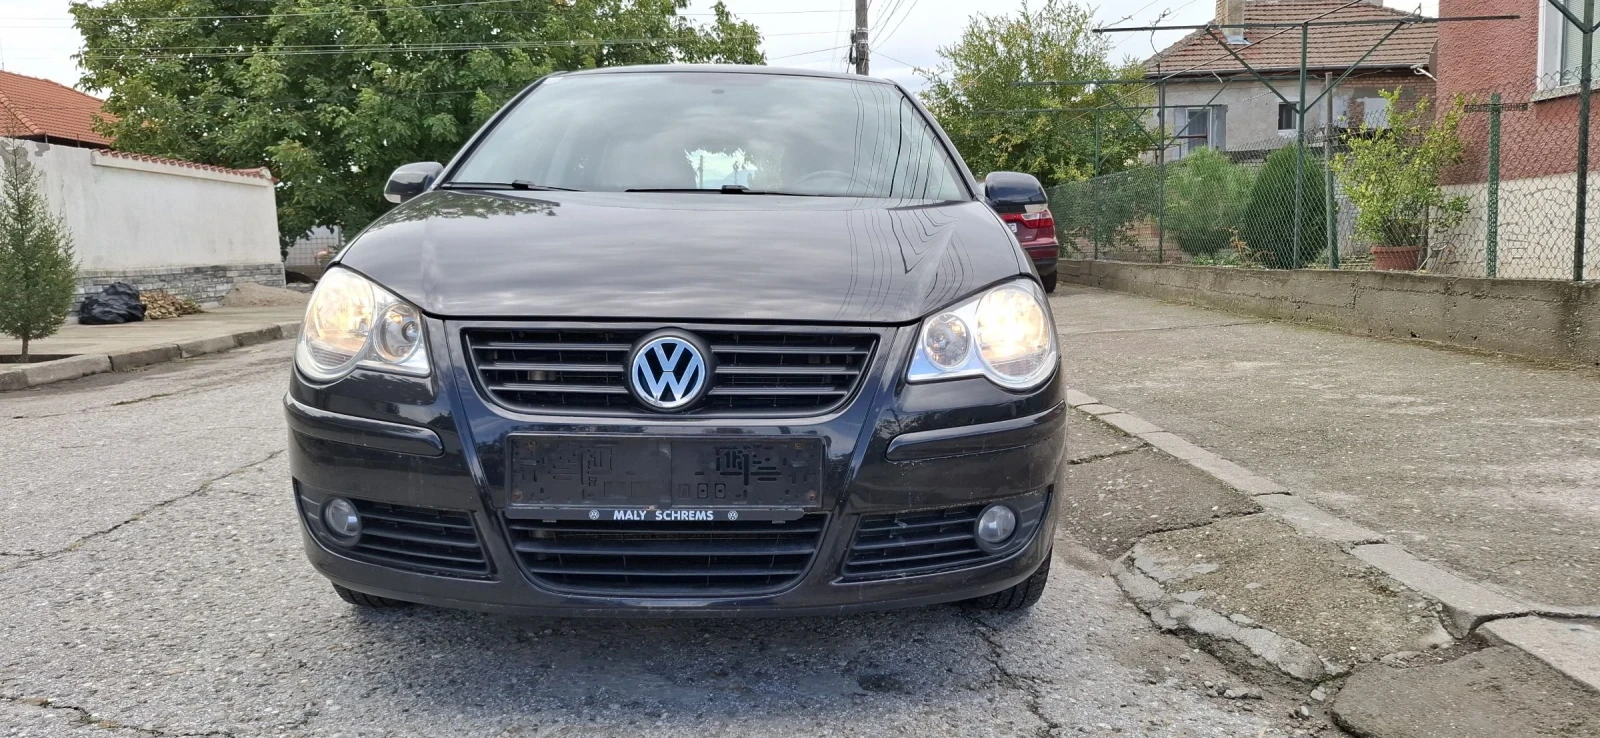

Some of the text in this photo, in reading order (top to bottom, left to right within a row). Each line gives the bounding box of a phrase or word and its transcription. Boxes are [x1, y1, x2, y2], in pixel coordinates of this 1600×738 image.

[633, 338, 704, 407] VW
[613, 510, 647, 521] MALY
[655, 510, 714, 521] SCHREMS
